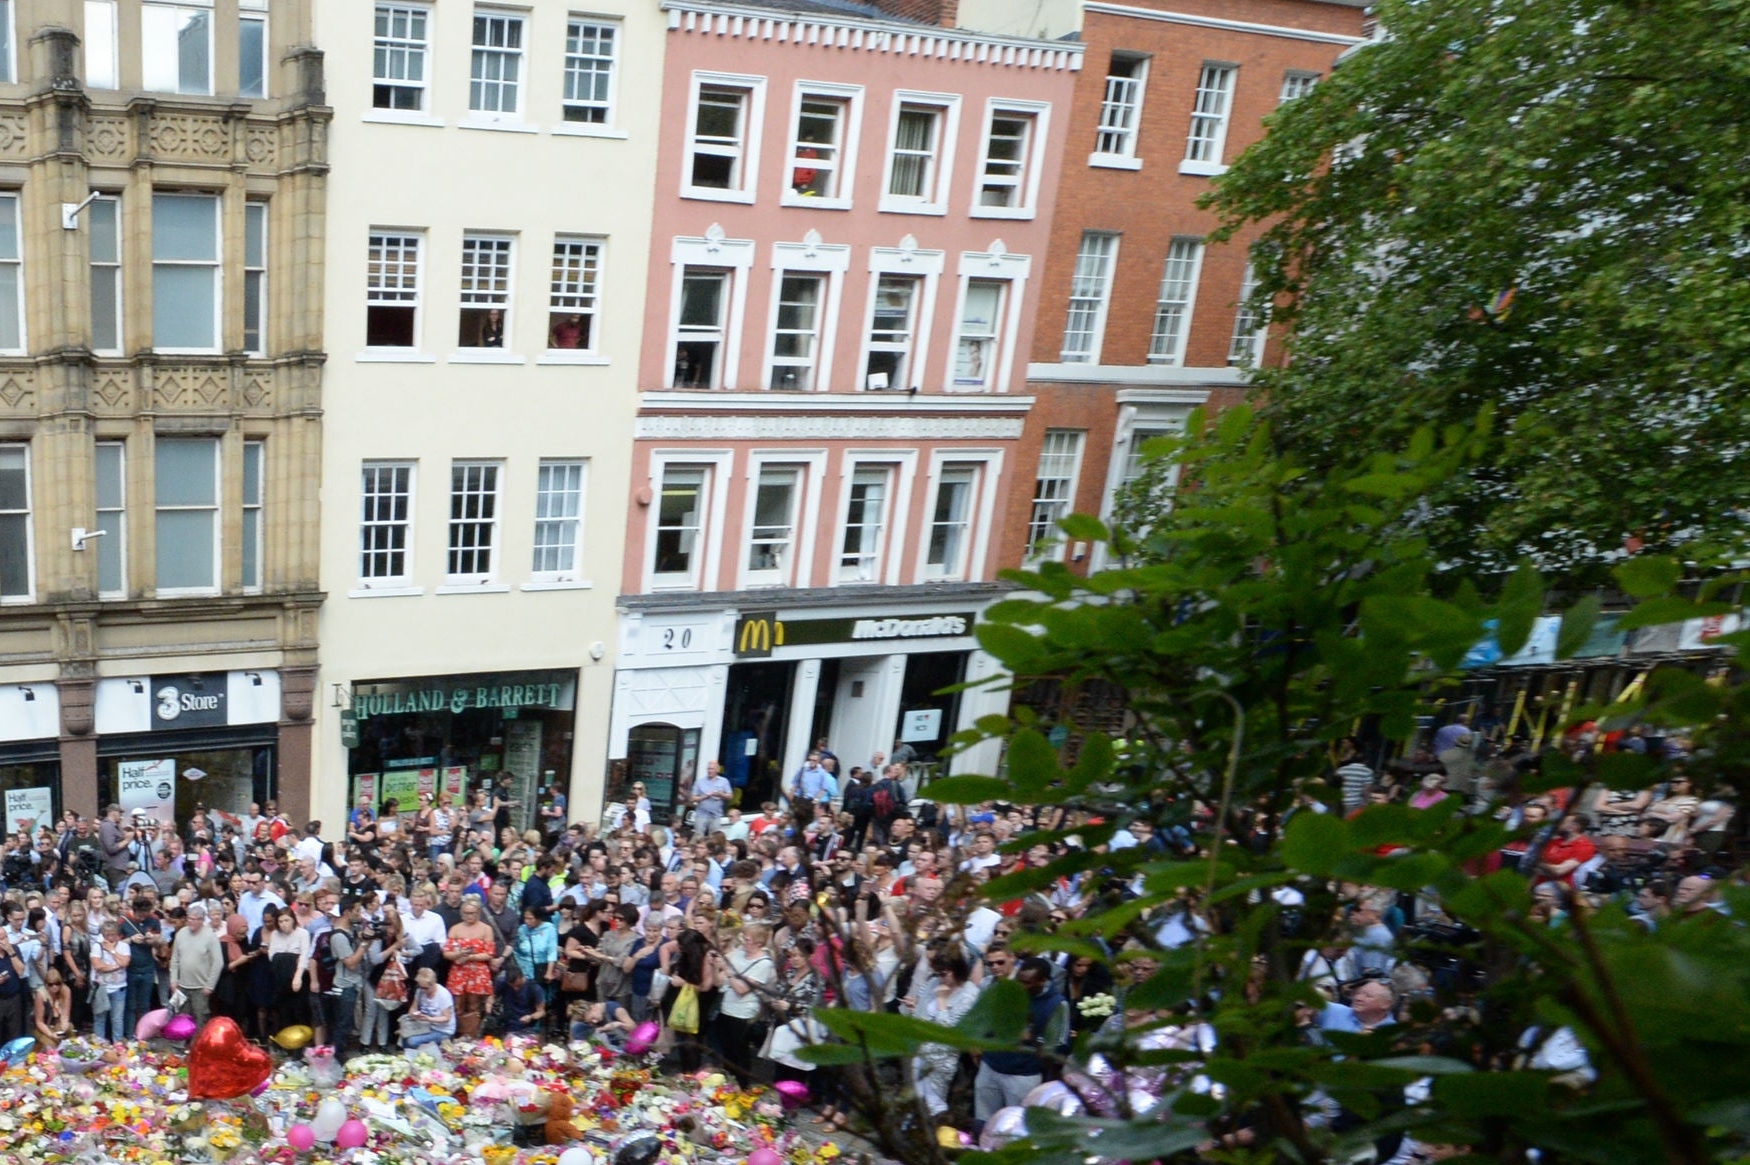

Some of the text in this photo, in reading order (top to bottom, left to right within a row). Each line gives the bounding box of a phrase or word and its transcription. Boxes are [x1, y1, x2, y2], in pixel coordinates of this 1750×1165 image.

[852, 616, 967, 639] McDonald's
[156, 686, 218, 721] 3 Store
[355, 684, 562, 720] HOLLAND & BARRETT
[122, 766, 144, 778] Half
[123, 780, 153, 792] price.
[8, 792, 26, 802] Half
